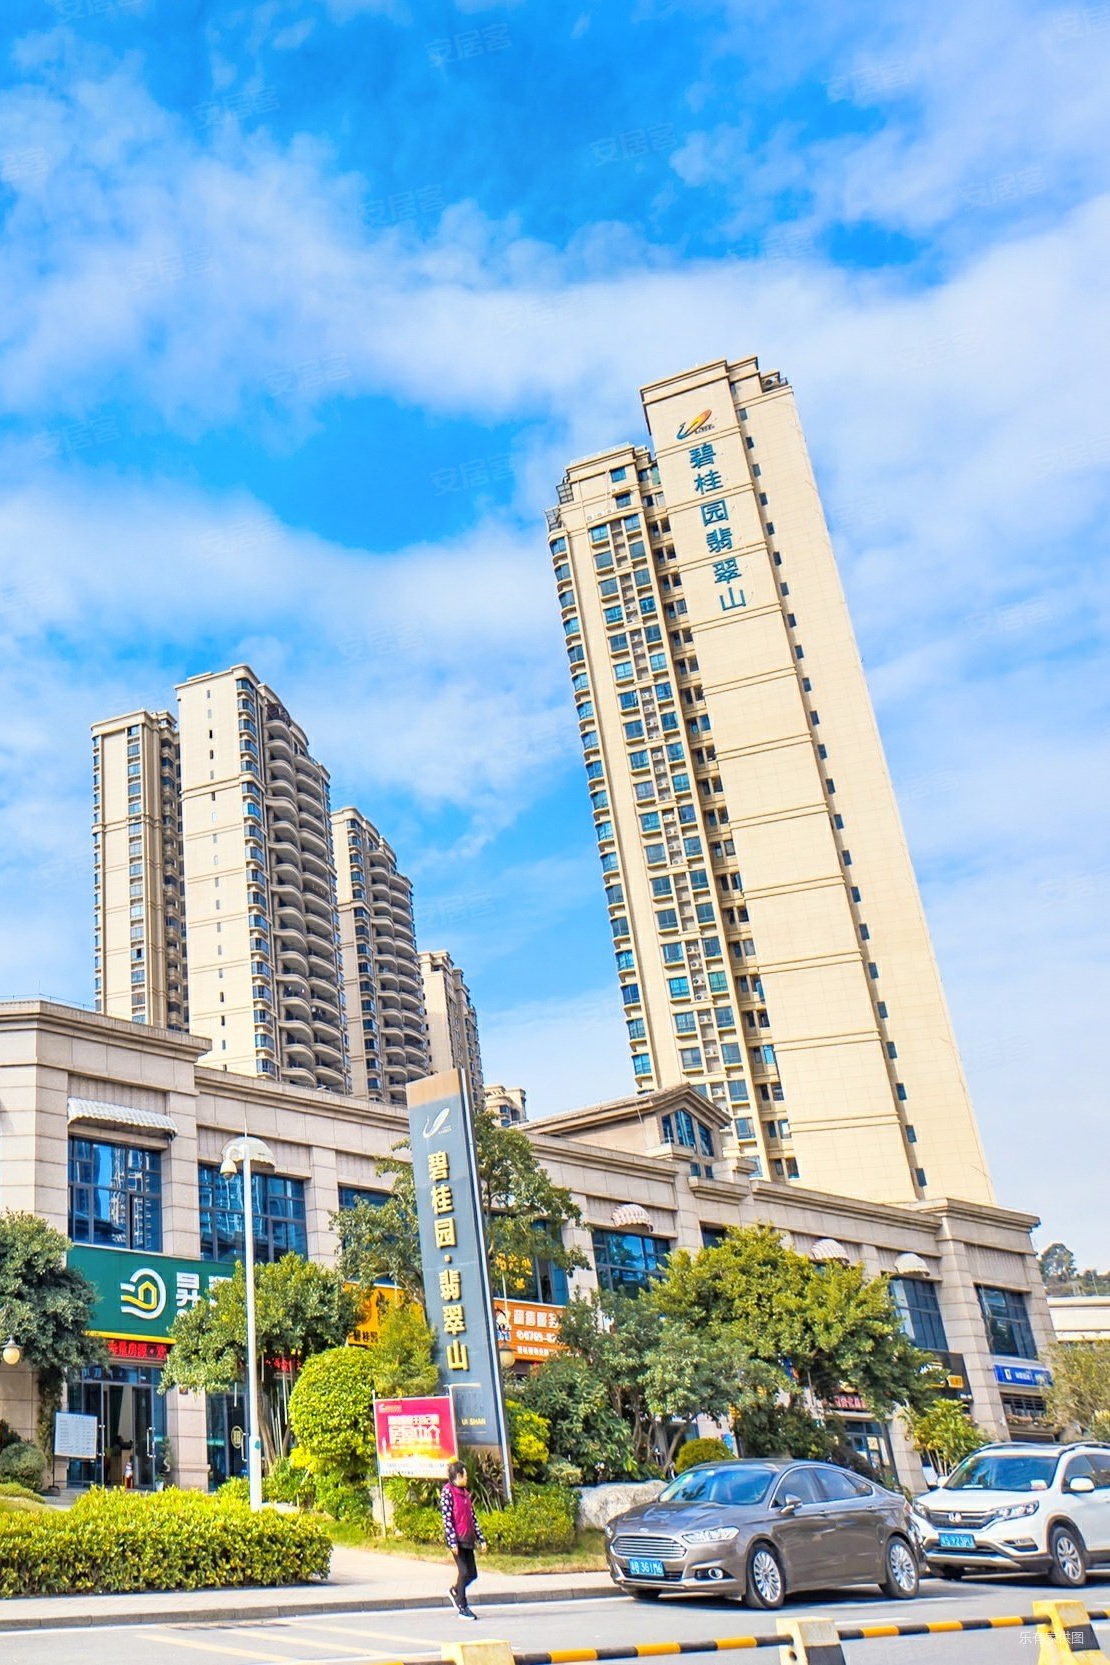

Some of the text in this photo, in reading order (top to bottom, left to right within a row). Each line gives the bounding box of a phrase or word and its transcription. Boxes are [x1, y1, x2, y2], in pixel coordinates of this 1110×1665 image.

[689, 442, 747, 612] 碧桂园翡翠山
